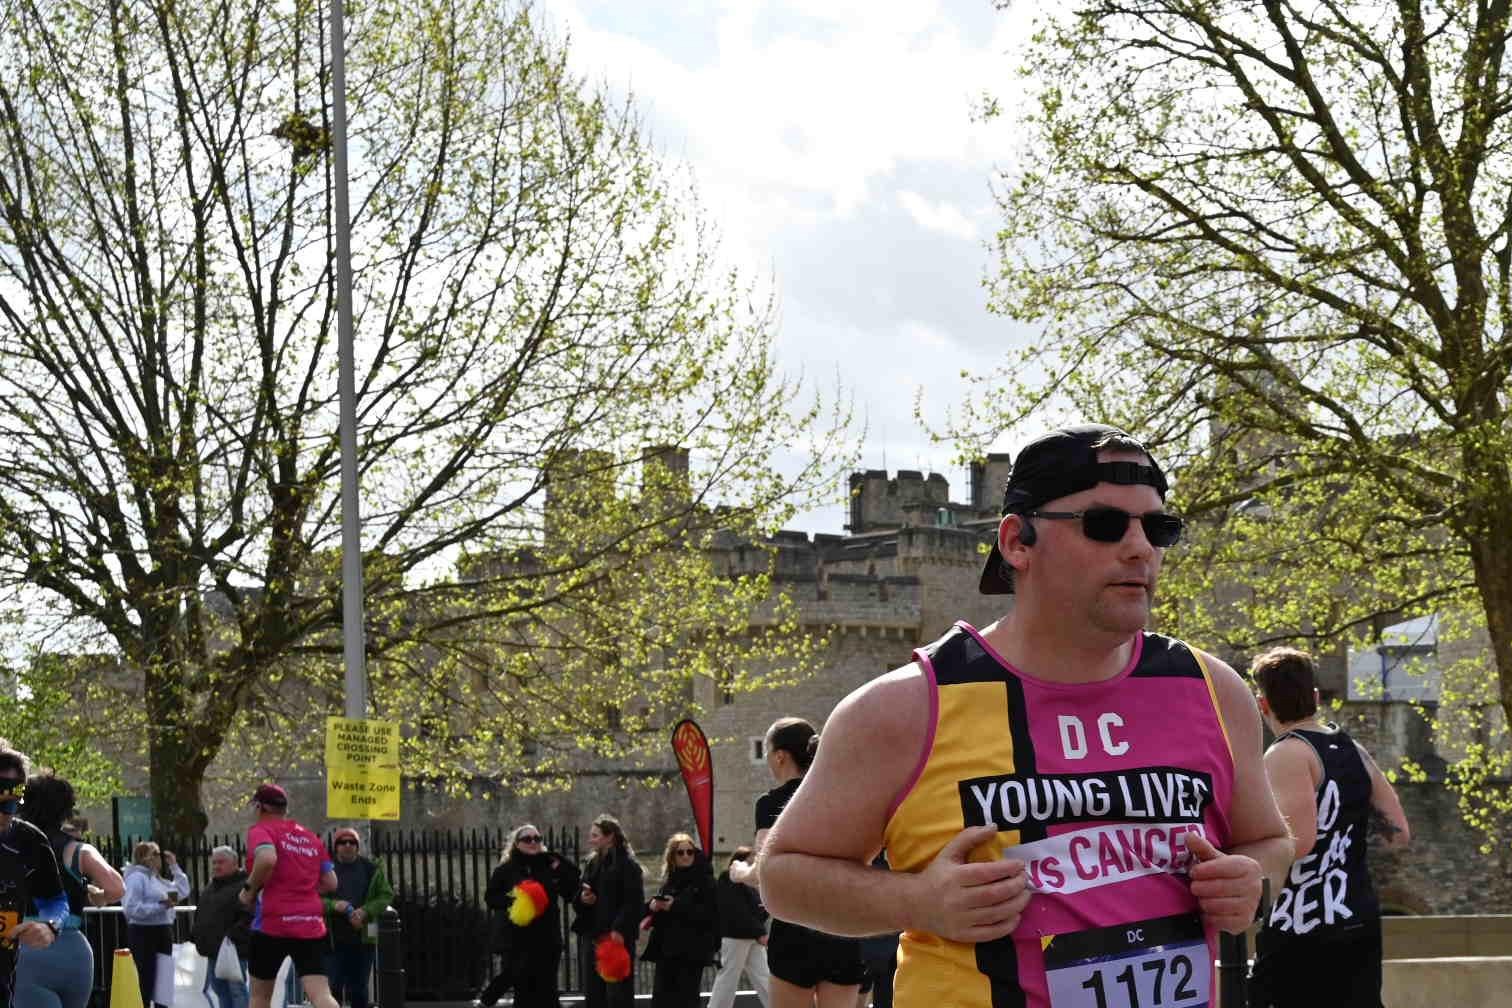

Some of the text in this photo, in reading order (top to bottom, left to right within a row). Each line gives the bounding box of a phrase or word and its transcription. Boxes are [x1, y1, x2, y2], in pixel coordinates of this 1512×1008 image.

[333, 722, 392, 737] PLEASE USE
[337, 733, 388, 745] MANAGED
[336, 743, 388, 754] CROSSING
[346, 753, 377, 763] POINT
[331, 780, 396, 793] Waste Zone
[351, 794, 377, 805] Ends
[970, 772, 1208, 825] YOUNG LIVES
[1268, 867, 1354, 935] BER
[1126, 929, 1145, 943] DC
